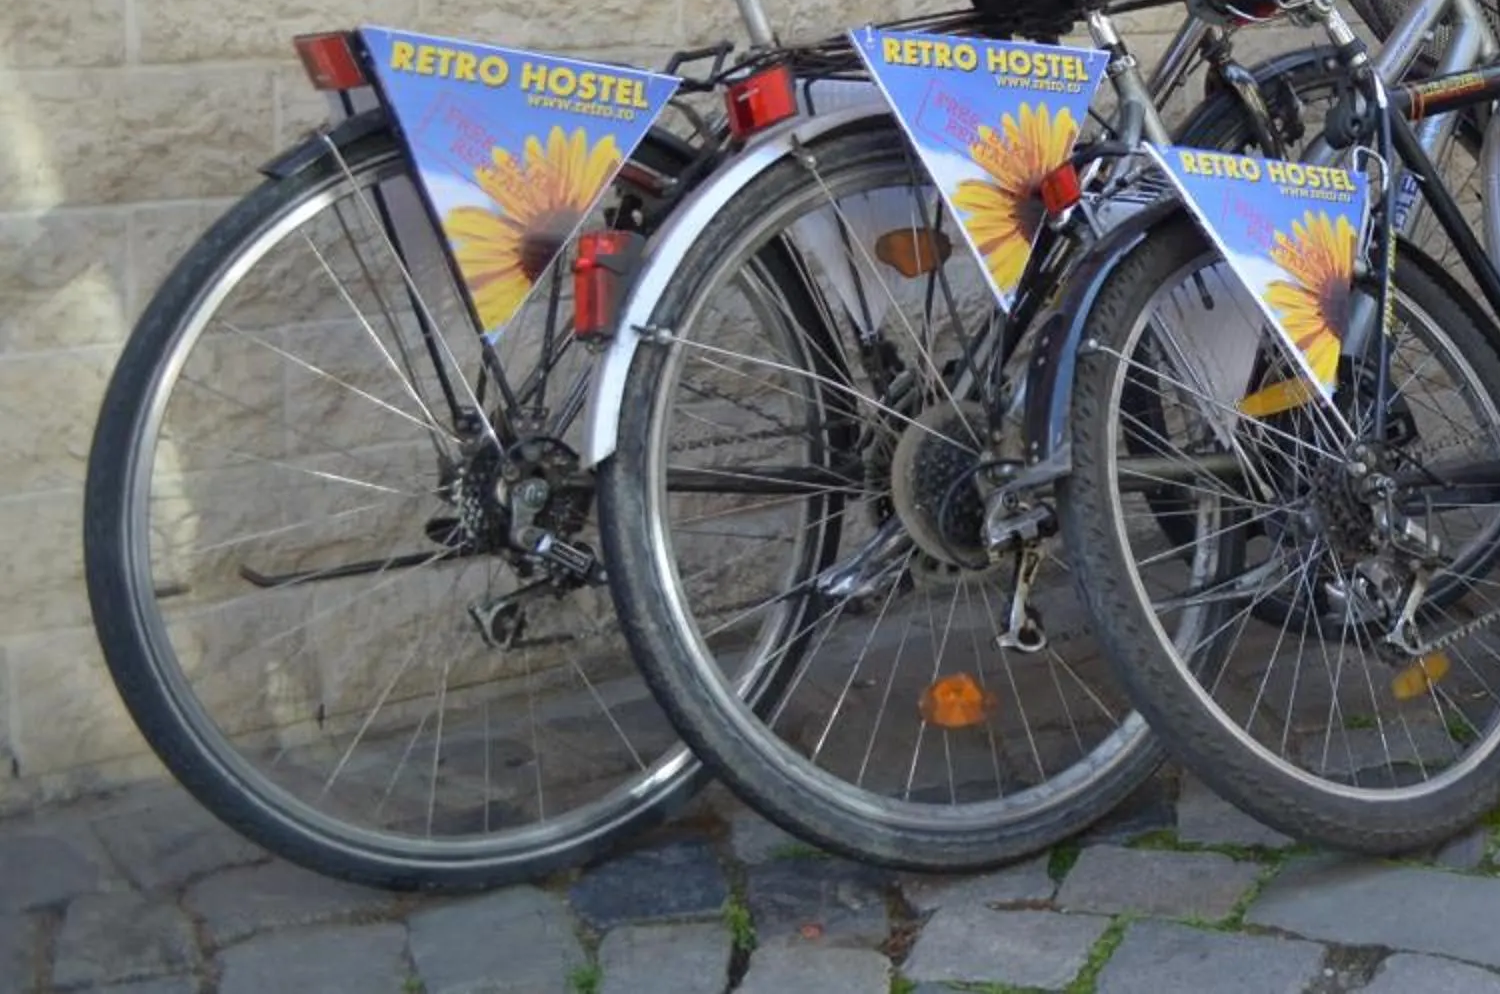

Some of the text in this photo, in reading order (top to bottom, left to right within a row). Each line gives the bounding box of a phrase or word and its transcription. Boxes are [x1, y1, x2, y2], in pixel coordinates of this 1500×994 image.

[390, 41, 648, 109] RETRO HOSTEL
[882, 37, 1089, 82] RETRO HOSTEL
[1180, 150, 1357, 192] RETRO HOSTEL
